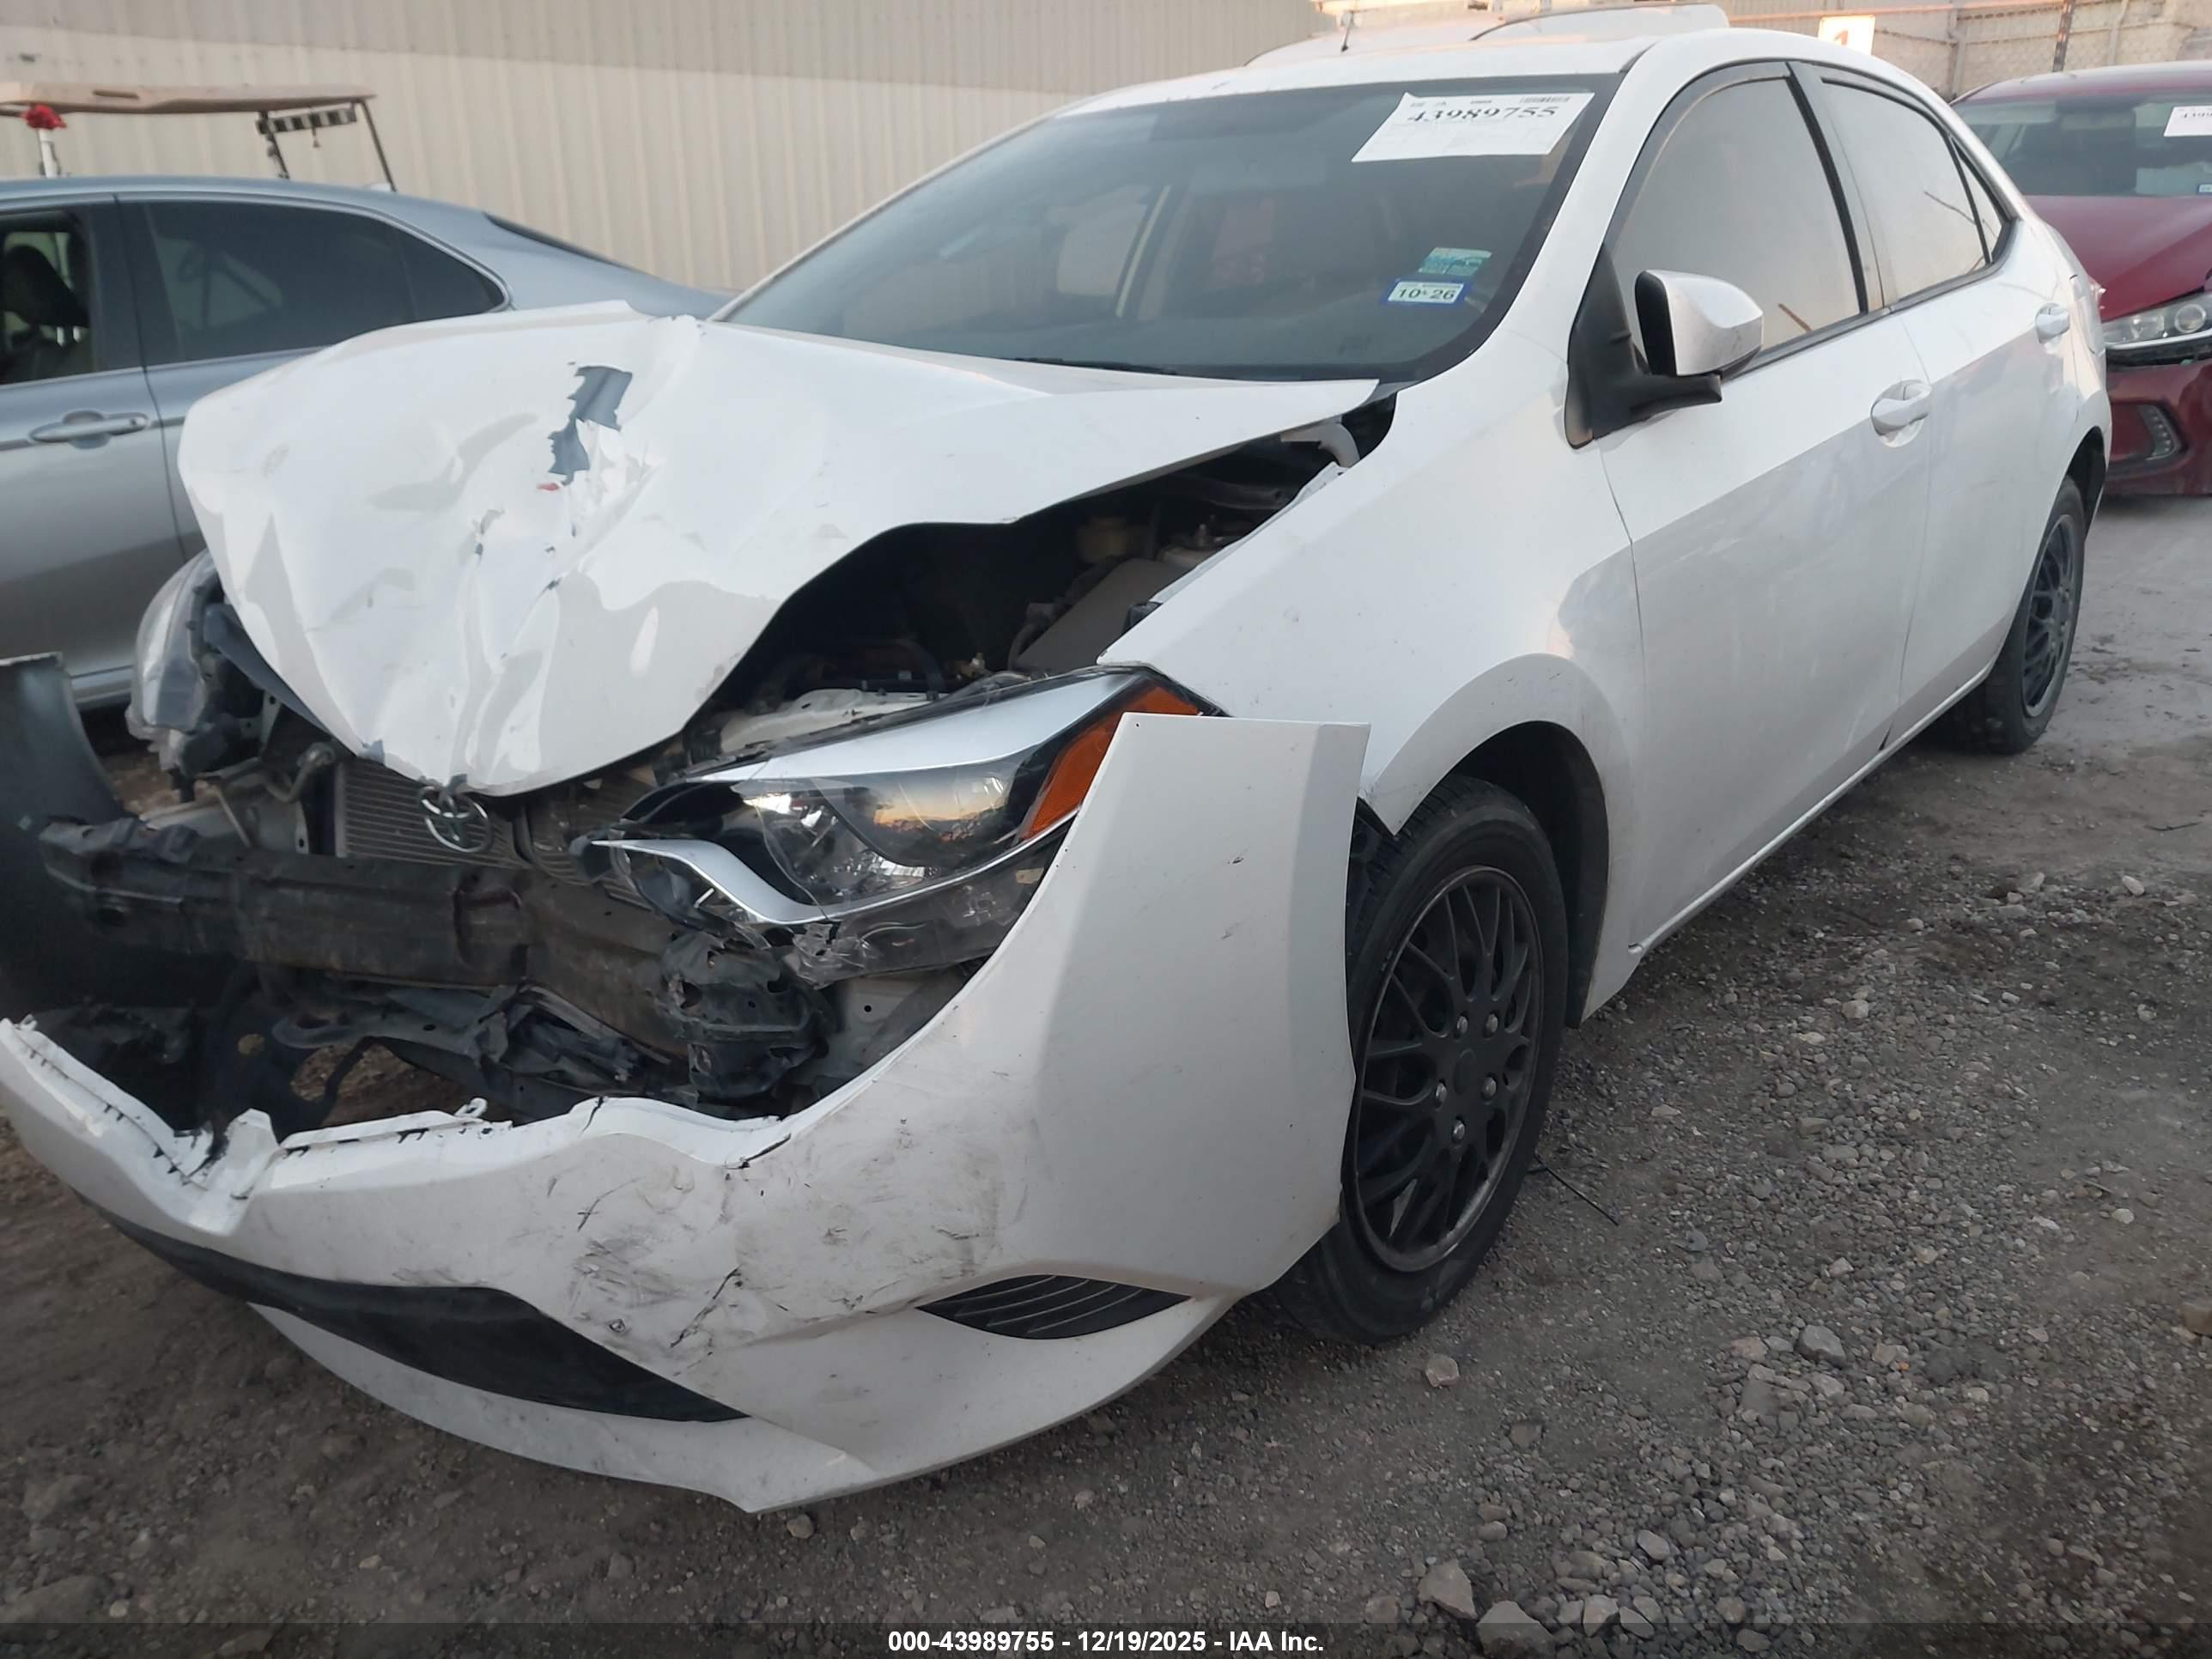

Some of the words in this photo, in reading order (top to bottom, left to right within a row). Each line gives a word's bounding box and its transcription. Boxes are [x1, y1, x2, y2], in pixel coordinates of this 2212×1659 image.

[1407, 106, 1559, 122] 43989755
[1400, 289, 1421, 298] 10
[1429, 289, 1455, 300] 26
